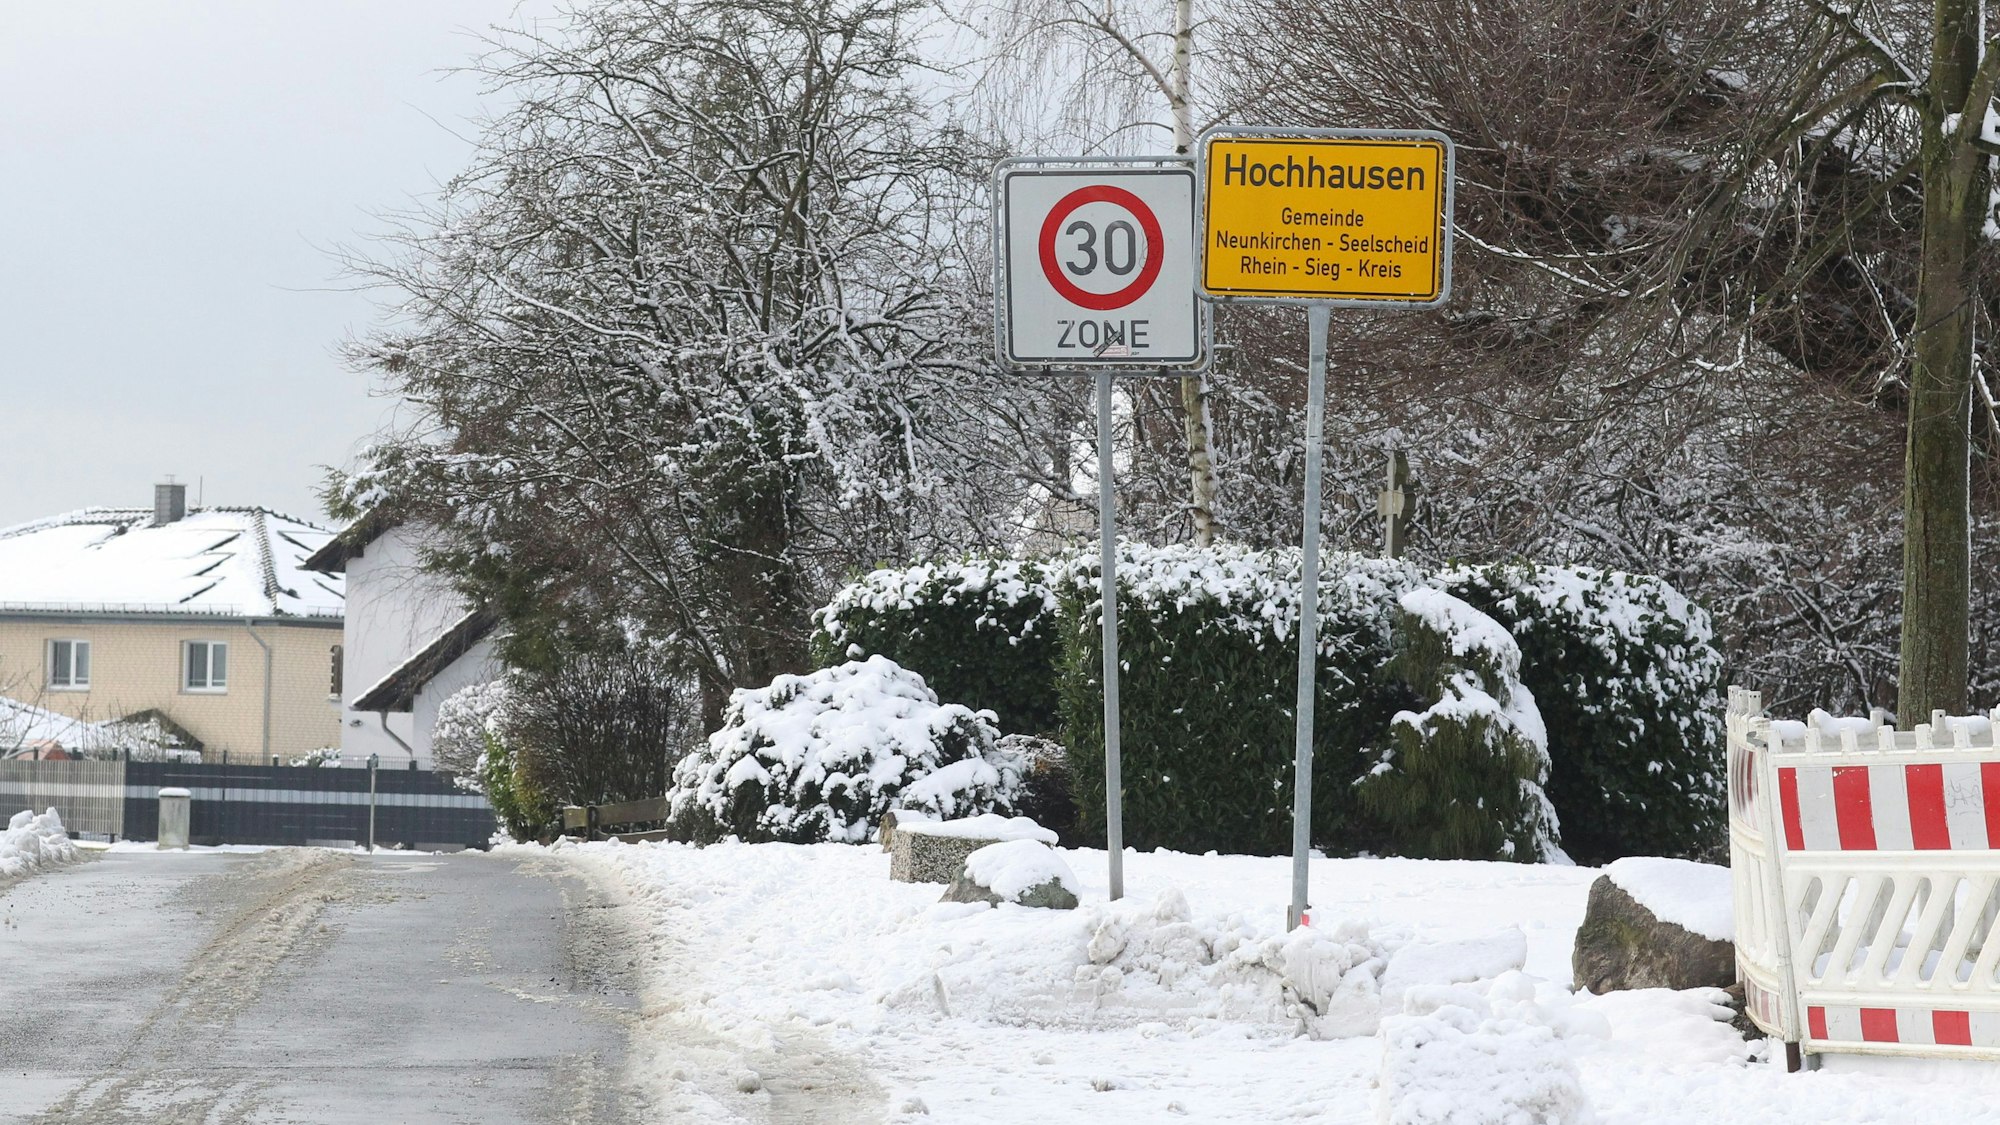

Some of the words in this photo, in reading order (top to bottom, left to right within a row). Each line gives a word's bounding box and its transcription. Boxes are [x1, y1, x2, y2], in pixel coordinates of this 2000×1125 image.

[1224, 153, 1425, 191] Hochhausen
[1281, 206, 1364, 228] Gemeinde
[1065, 220, 1137, 276] 30
[1216, 229, 1321, 251] Neunkirchen
[1338, 233, 1429, 254] Seelscheid
[1240, 256, 1287, 275] Rhein
[1304, 257, 1340, 282] Sieg
[1358, 259, 1402, 279] Kreis
[1057, 319, 1150, 349] ZONE
